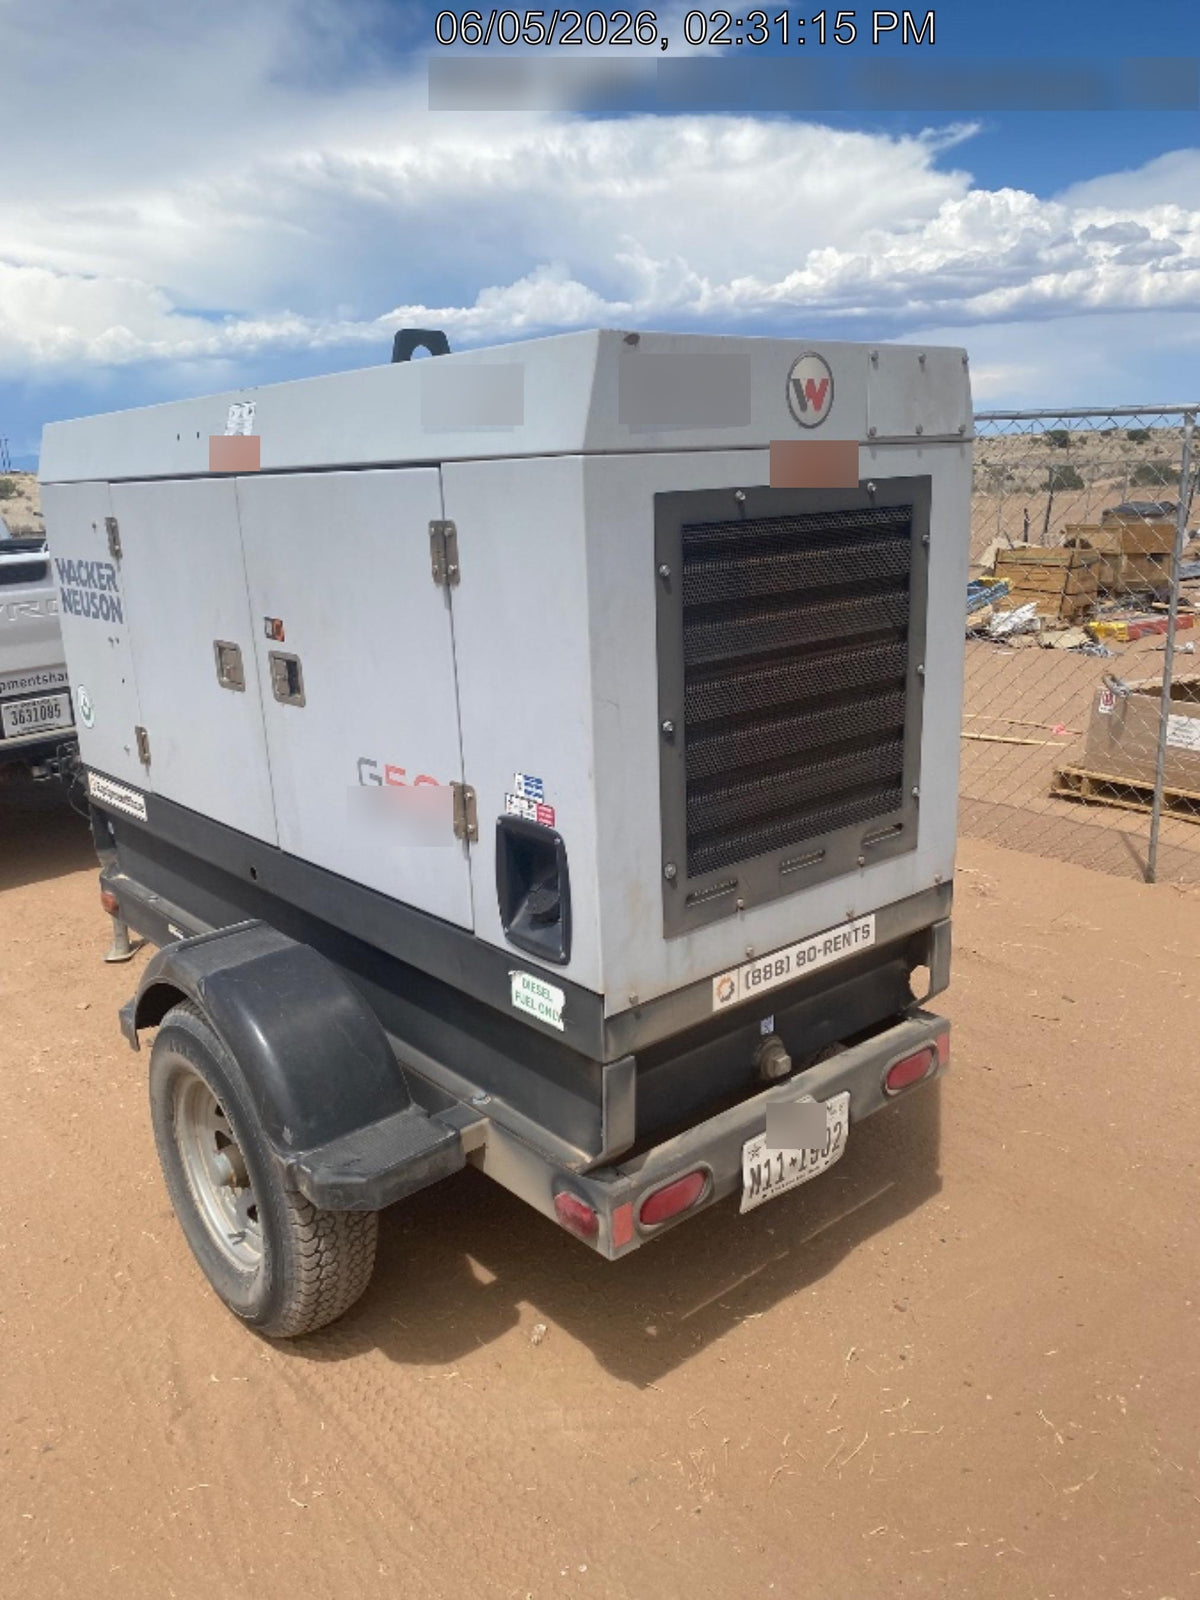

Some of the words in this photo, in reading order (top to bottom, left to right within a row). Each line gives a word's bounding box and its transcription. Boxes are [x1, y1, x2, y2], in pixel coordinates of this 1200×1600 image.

[54, 557, 119, 593] WACKER
[60, 586, 124, 625] NEUSON
[357, 756, 441, 786] G5
[744, 958, 791, 991] (888)
[796, 923, 872, 966] 80-RENTS
[515, 989, 537, 1010] FUEL
[522, 977, 553, 1001] DIESEL
